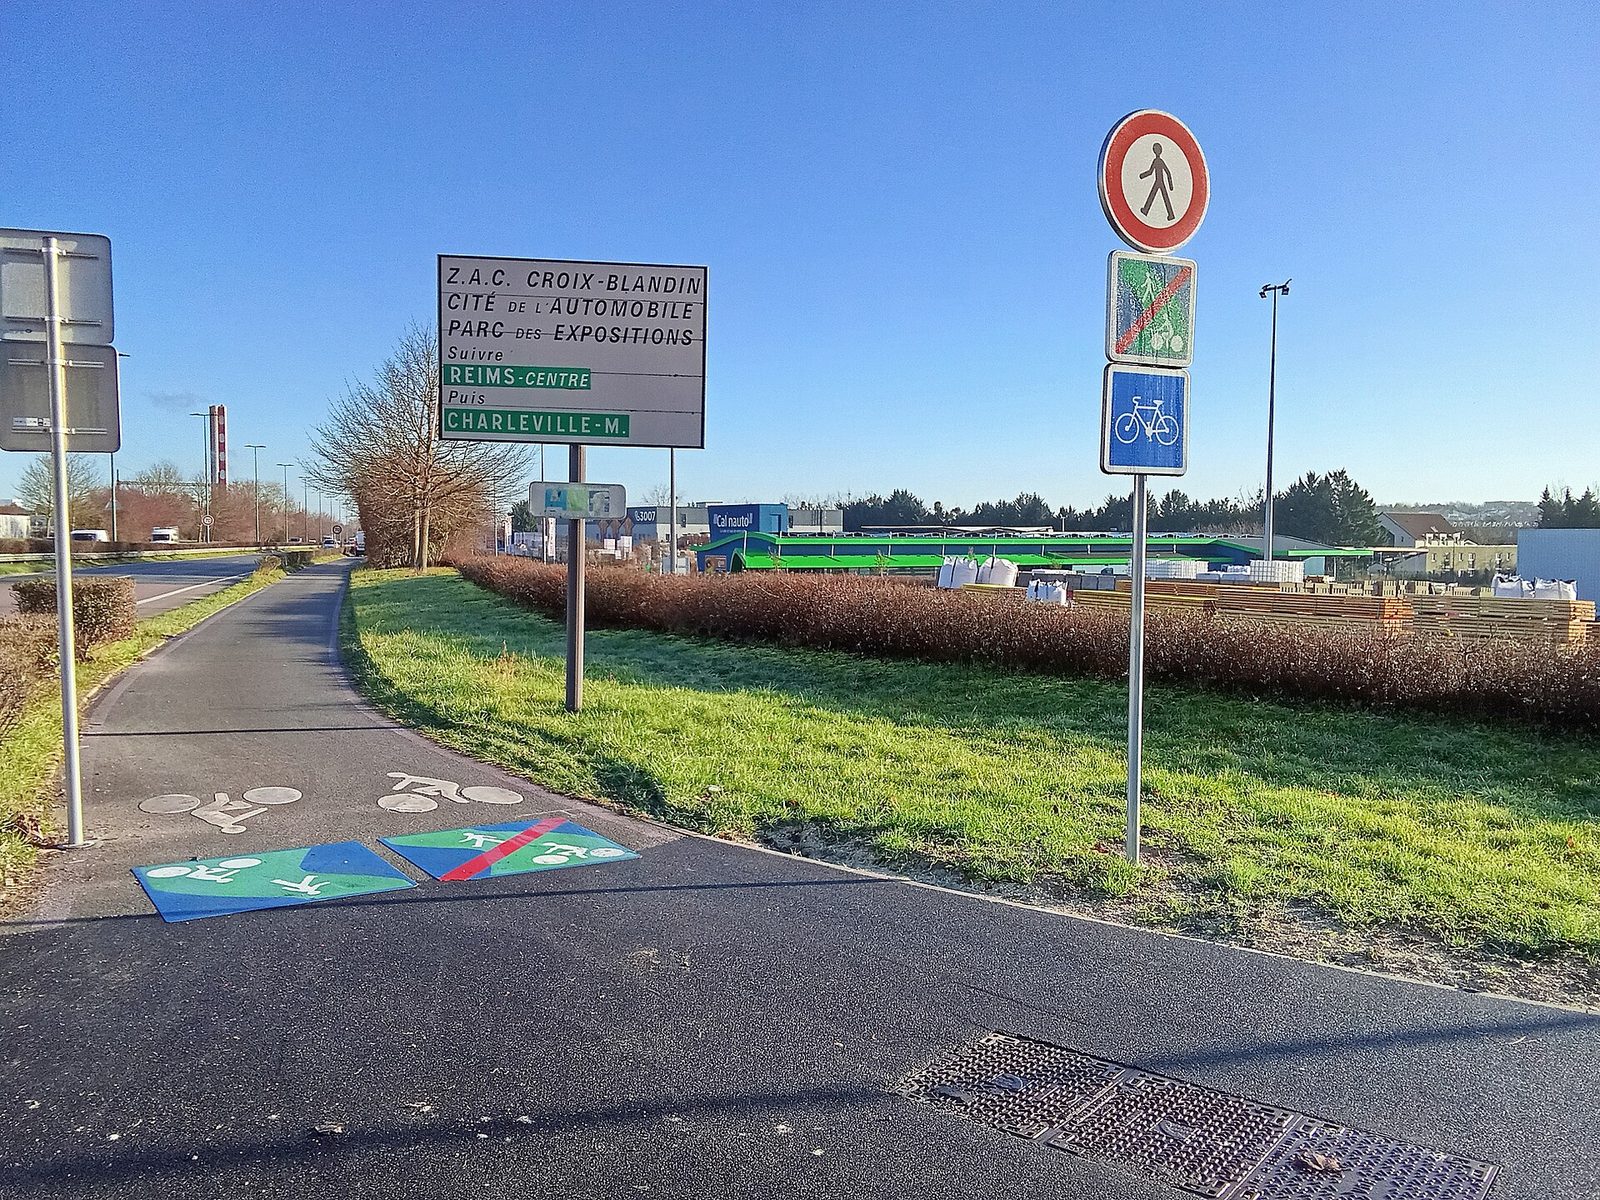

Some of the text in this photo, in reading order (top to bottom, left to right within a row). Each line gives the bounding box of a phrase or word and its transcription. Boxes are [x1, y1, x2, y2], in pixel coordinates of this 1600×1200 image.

[447, 267, 701, 294] Z.A.C. CROIX-BLANDIN
[448, 291, 694, 320] CITÉ DE L'AUTOMOBILE
[448, 320, 694, 346] PARC DES EXPOSITIONS
[448, 346, 503, 362] Suivre
[450, 366, 589, 388] REIMS-CENTRE
[448, 390, 486, 405] Puis
[448, 412, 627, 435] CHARLEVILLE-M.
